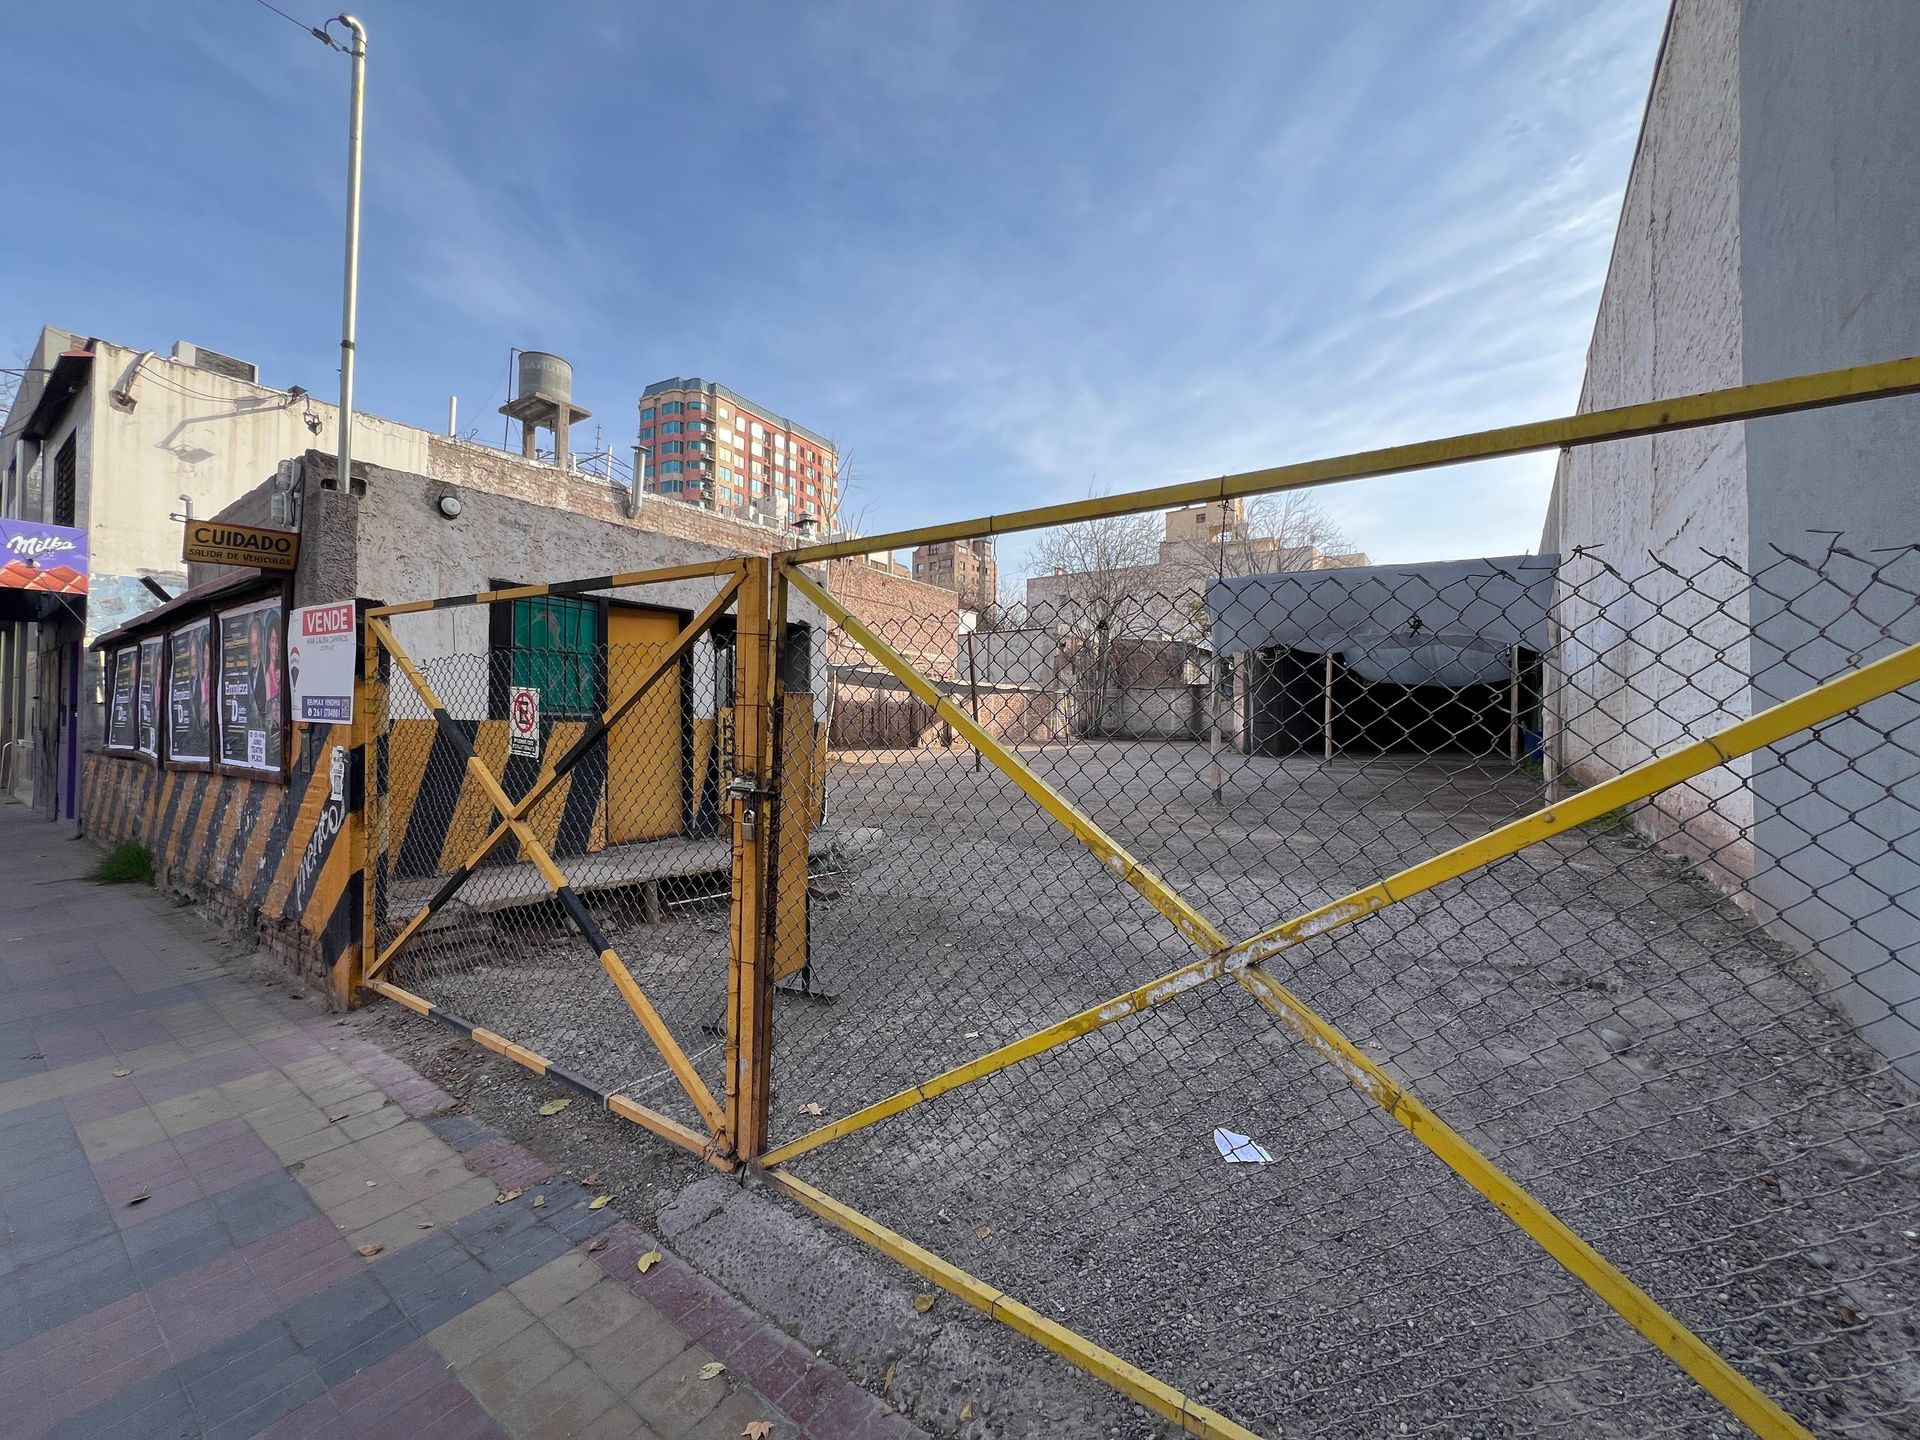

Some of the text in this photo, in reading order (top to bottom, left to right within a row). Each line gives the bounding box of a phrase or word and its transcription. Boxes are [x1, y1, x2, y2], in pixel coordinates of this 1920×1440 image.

[6, 535, 77, 555] Milka
[194, 527, 292, 553] CUIDADO
[188, 548, 291, 566] SALIDA DE VEHICULOS
[306, 608, 348, 633] VENDE
